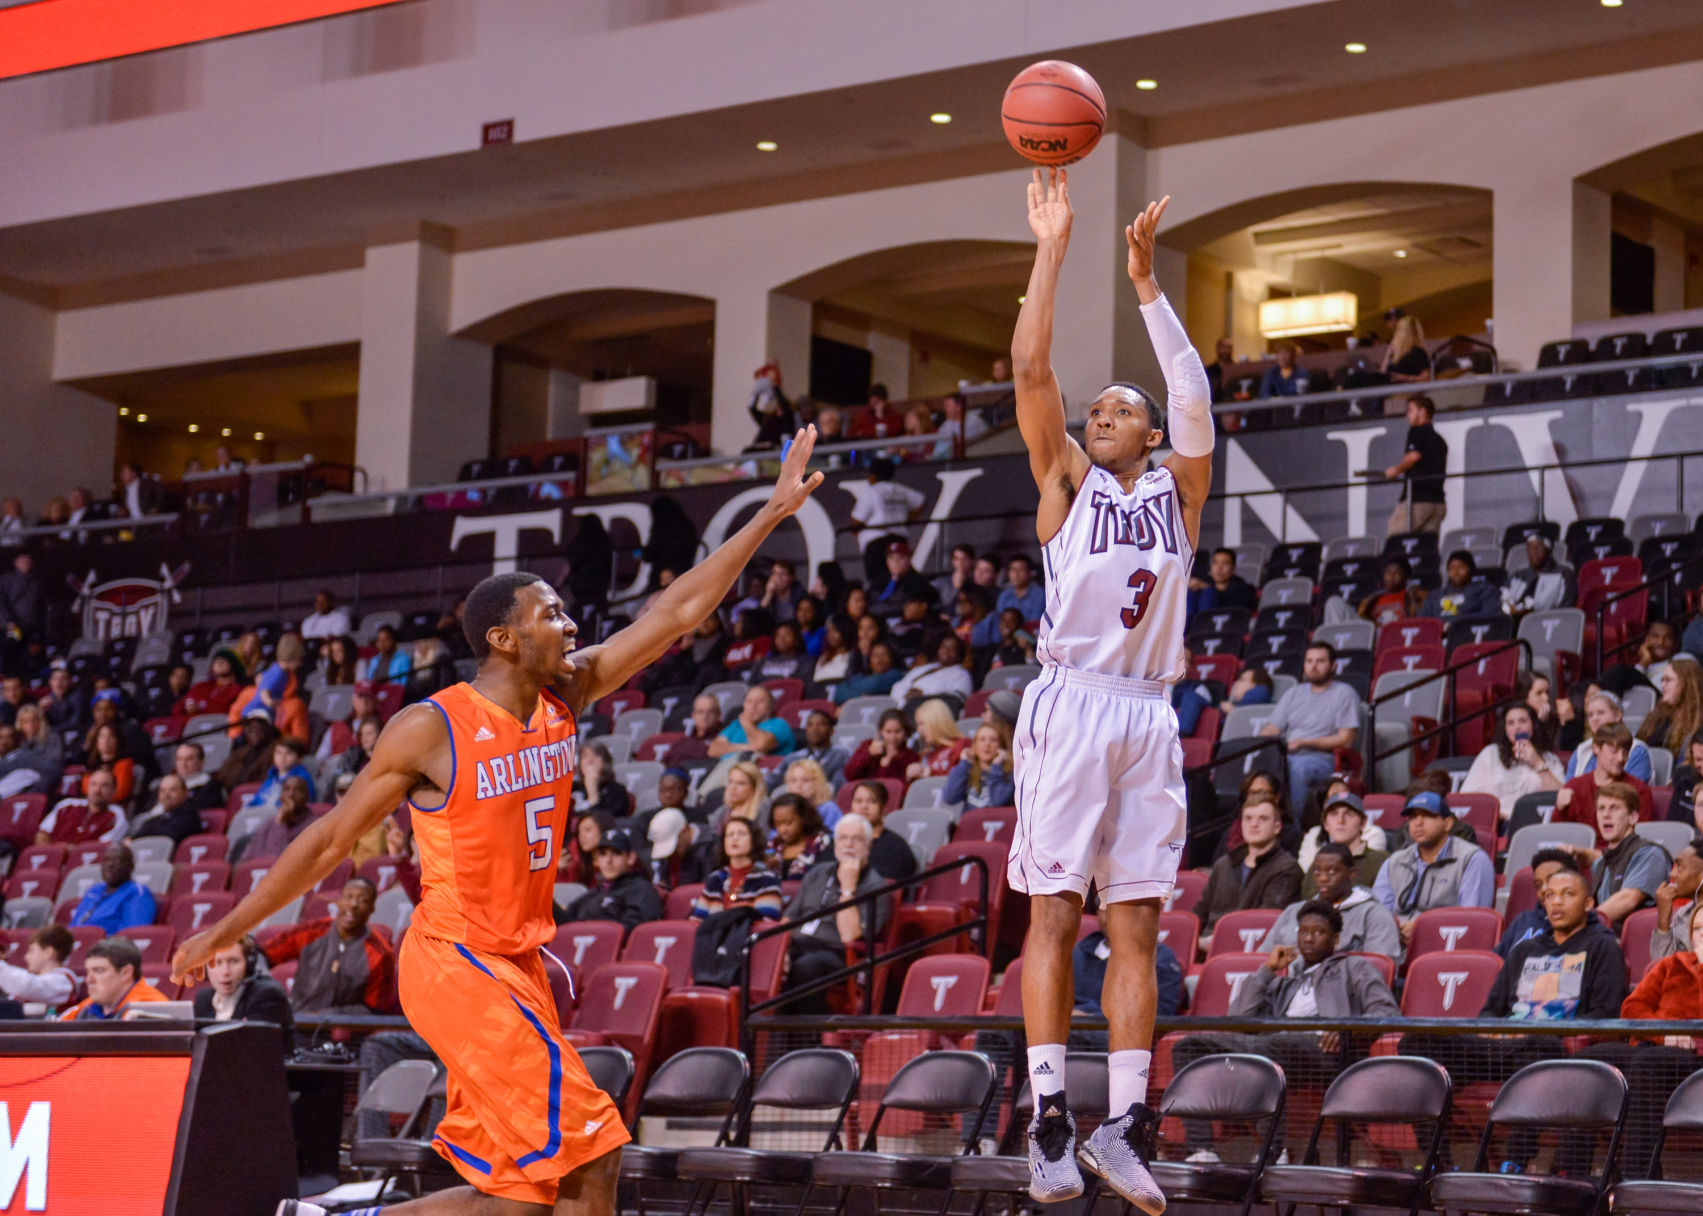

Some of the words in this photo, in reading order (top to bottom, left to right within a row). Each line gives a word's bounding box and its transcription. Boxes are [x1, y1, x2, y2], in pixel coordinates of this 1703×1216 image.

[1018, 135, 1068, 152] NCAA
[1586, 525, 1603, 542] T
[1651, 521, 1668, 537] T
[1403, 538, 1419, 554] T
[1461, 534, 1476, 548] T
[1661, 542, 1680, 557] T
[1288, 547, 1304, 563] T
[1594, 545, 1612, 561] T
[1342, 563, 1359, 577] T
[1601, 566, 1620, 586] T
[1119, 567, 1158, 630] 3
[1278, 589, 1294, 604] T
[1340, 583, 1357, 600] T
[1212, 614, 1230, 632] T
[1275, 610, 1293, 628] T
[1401, 627, 1420, 647] T
[1471, 625, 1491, 645] T
[1541, 618, 1560, 642] T
[1203, 639, 1222, 656] T
[1268, 635, 1287, 654] T
[1335, 632, 1352, 649] T
[1197, 663, 1216, 680] T
[1264, 660, 1283, 675] T
[1335, 657, 1352, 675] T
[1403, 655, 1423, 672] T
[613, 700, 628, 720] T
[663, 697, 679, 719] T
[861, 706, 877, 725] T
[683, 718, 696, 737] T
[798, 709, 812, 728] T
[578, 722, 594, 744] T
[630, 721, 646, 742] T
[653, 744, 671, 761] T
[475, 734, 577, 801] ARLINGTON
[62, 775, 80, 795] T
[626, 772, 642, 792] T
[689, 768, 707, 797] T
[932, 788, 945, 809] T
[12, 802, 29, 824] T
[523, 794, 555, 872] 5
[190, 846, 207, 865] T
[192, 872, 210, 894] T
[251, 869, 269, 892] T
[377, 866, 396, 892] T
[22, 881, 39, 899] T
[11, 911, 28, 929] T
[192, 903, 213, 929] T
[398, 903, 414, 931] T
[574, 935, 597, 965] T
[654, 936, 677, 964] T
[614, 976, 638, 1010] T
[931, 976, 959, 1012] T
[1438, 971, 1469, 1010] T
